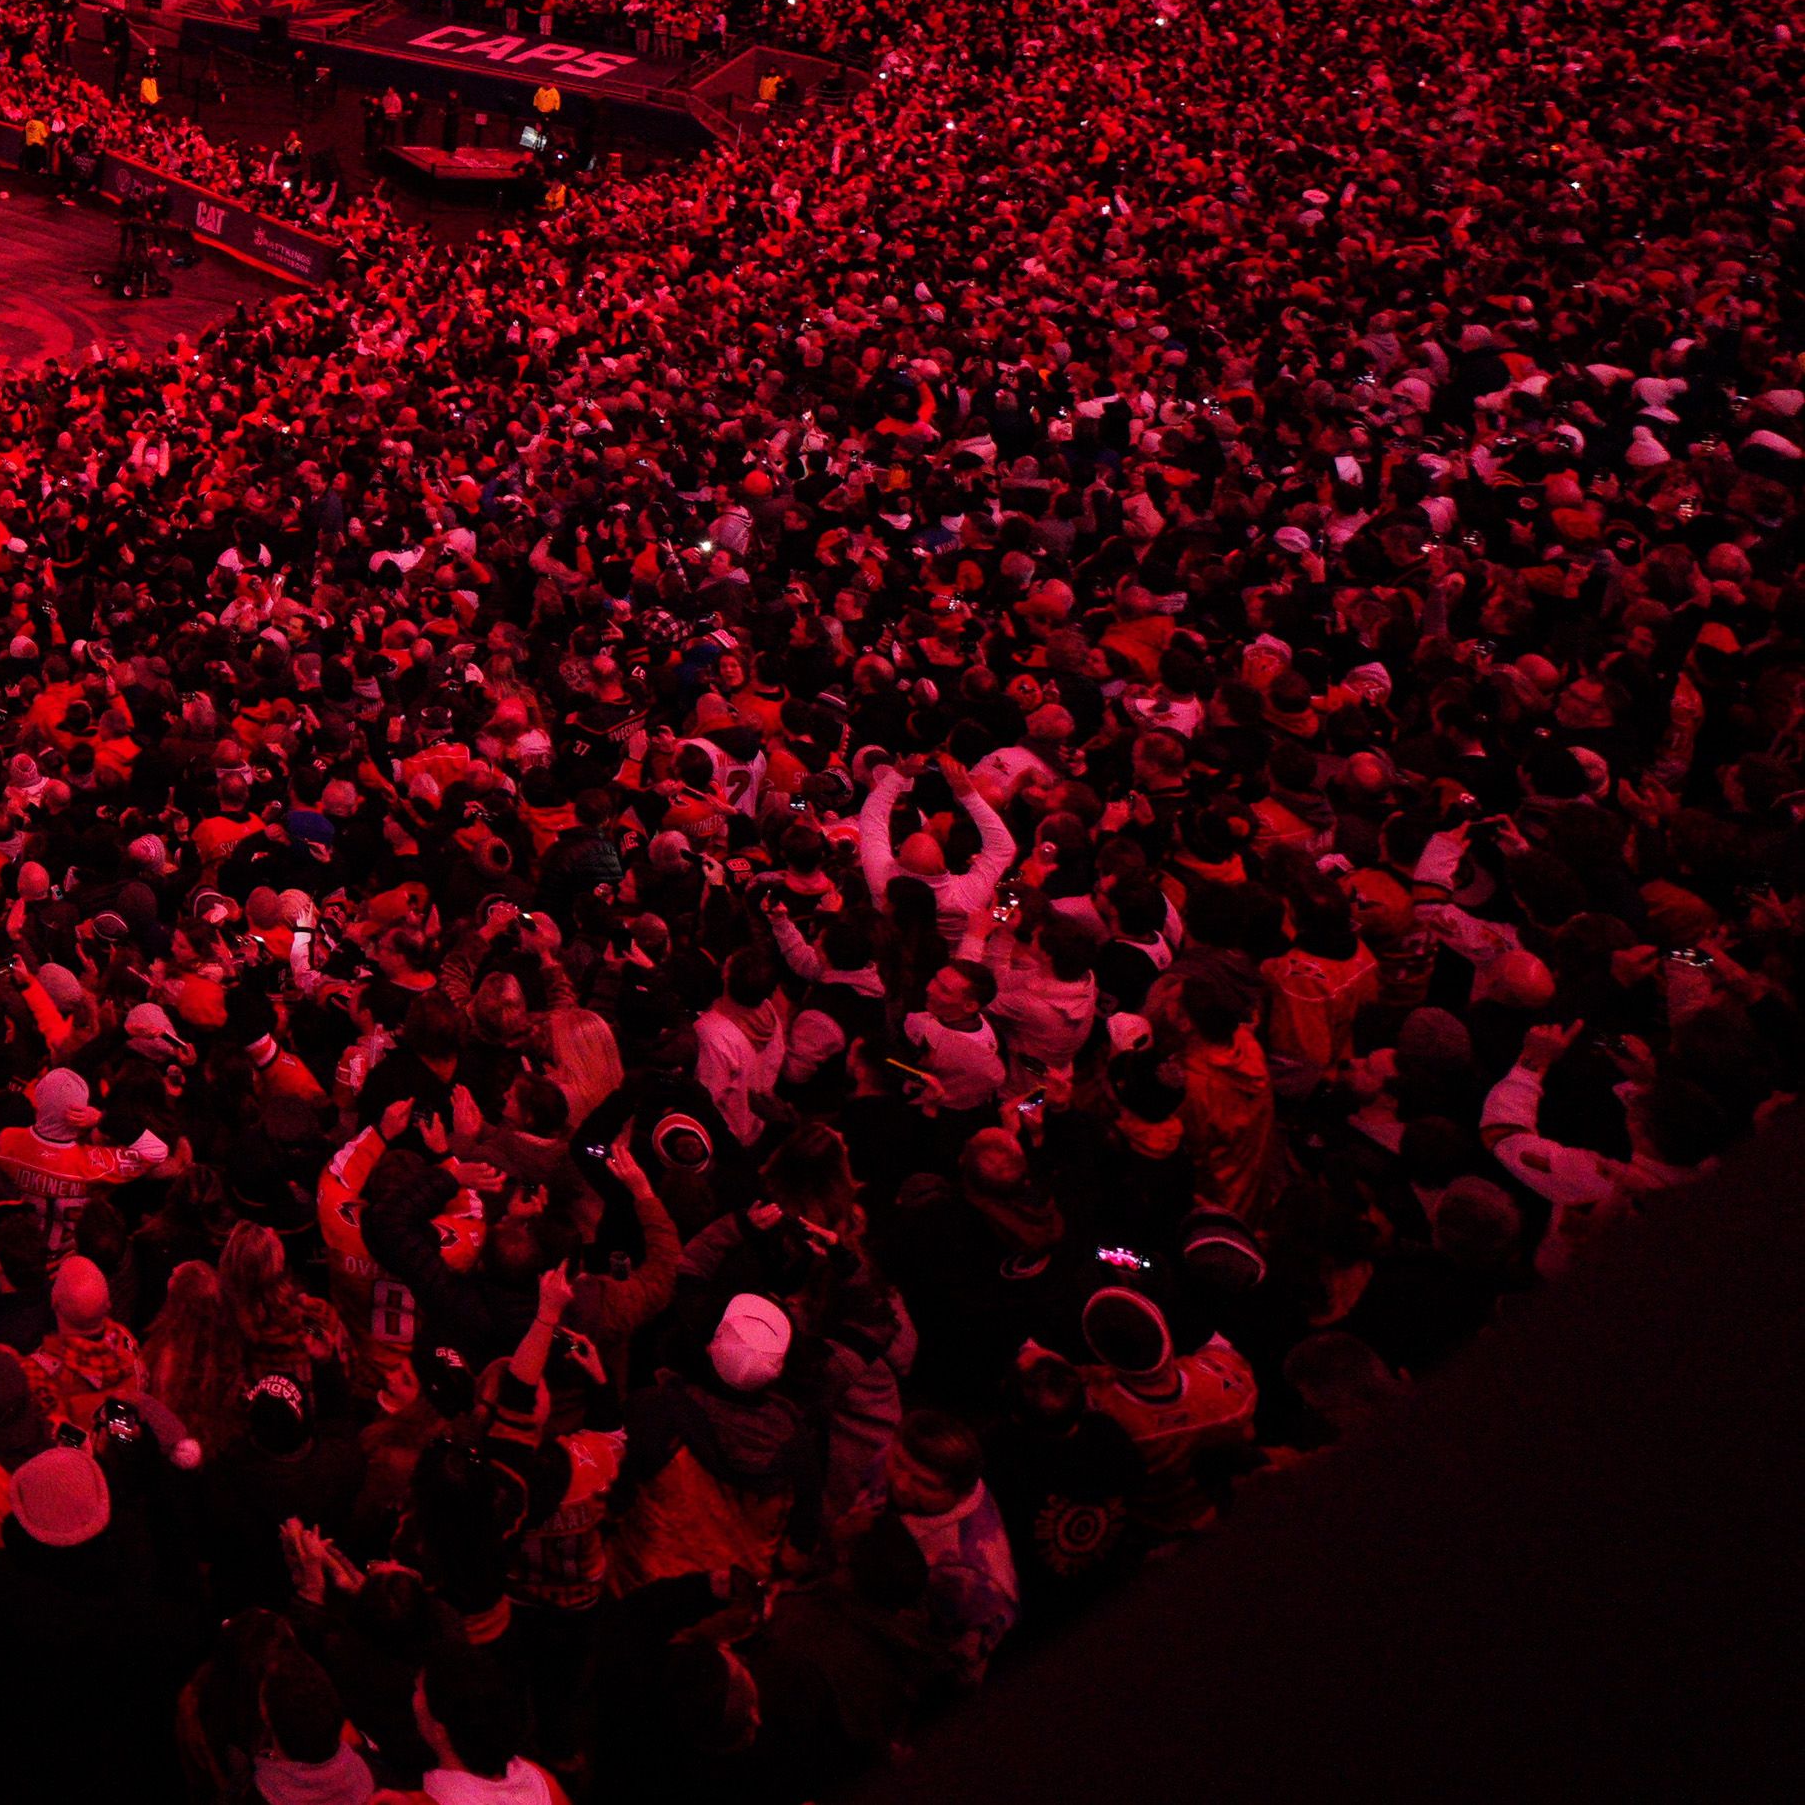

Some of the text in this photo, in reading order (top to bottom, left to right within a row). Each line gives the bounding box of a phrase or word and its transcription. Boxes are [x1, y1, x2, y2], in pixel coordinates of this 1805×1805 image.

[408, 25, 638, 79] CAPS
[196, 201, 225, 234] CAT
[372, 1280, 415, 1345] 8
